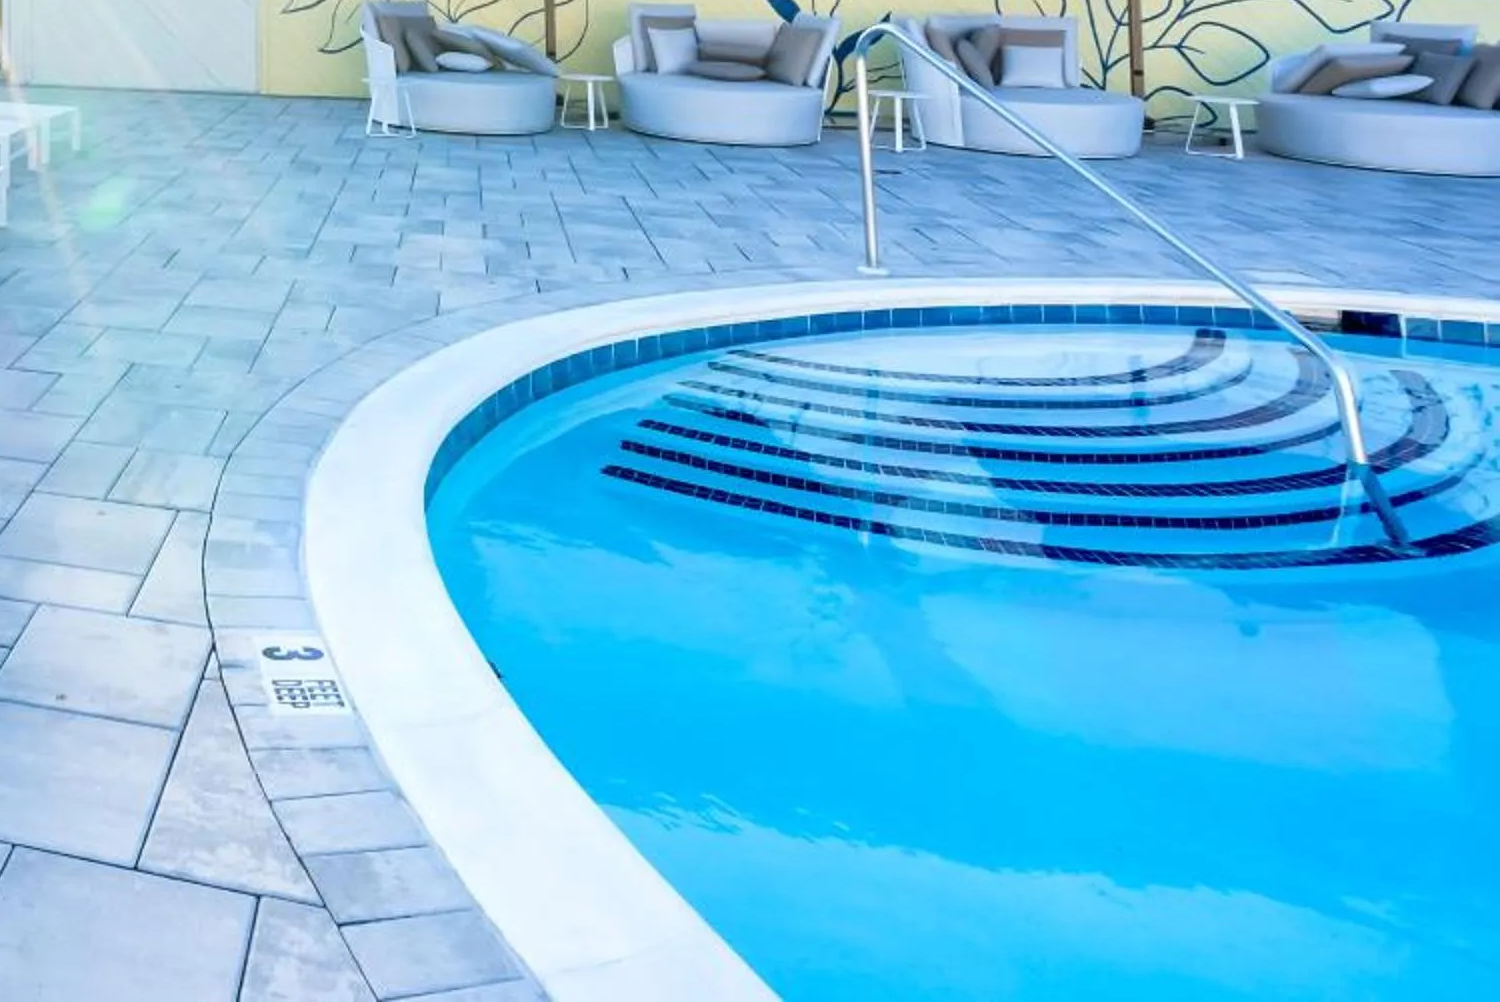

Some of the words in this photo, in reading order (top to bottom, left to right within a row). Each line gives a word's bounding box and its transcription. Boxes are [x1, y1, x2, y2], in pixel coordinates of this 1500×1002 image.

[262, 646, 324, 661] 3
[271, 679, 312, 709] DEEP
[303, 679, 345, 708] FEET
